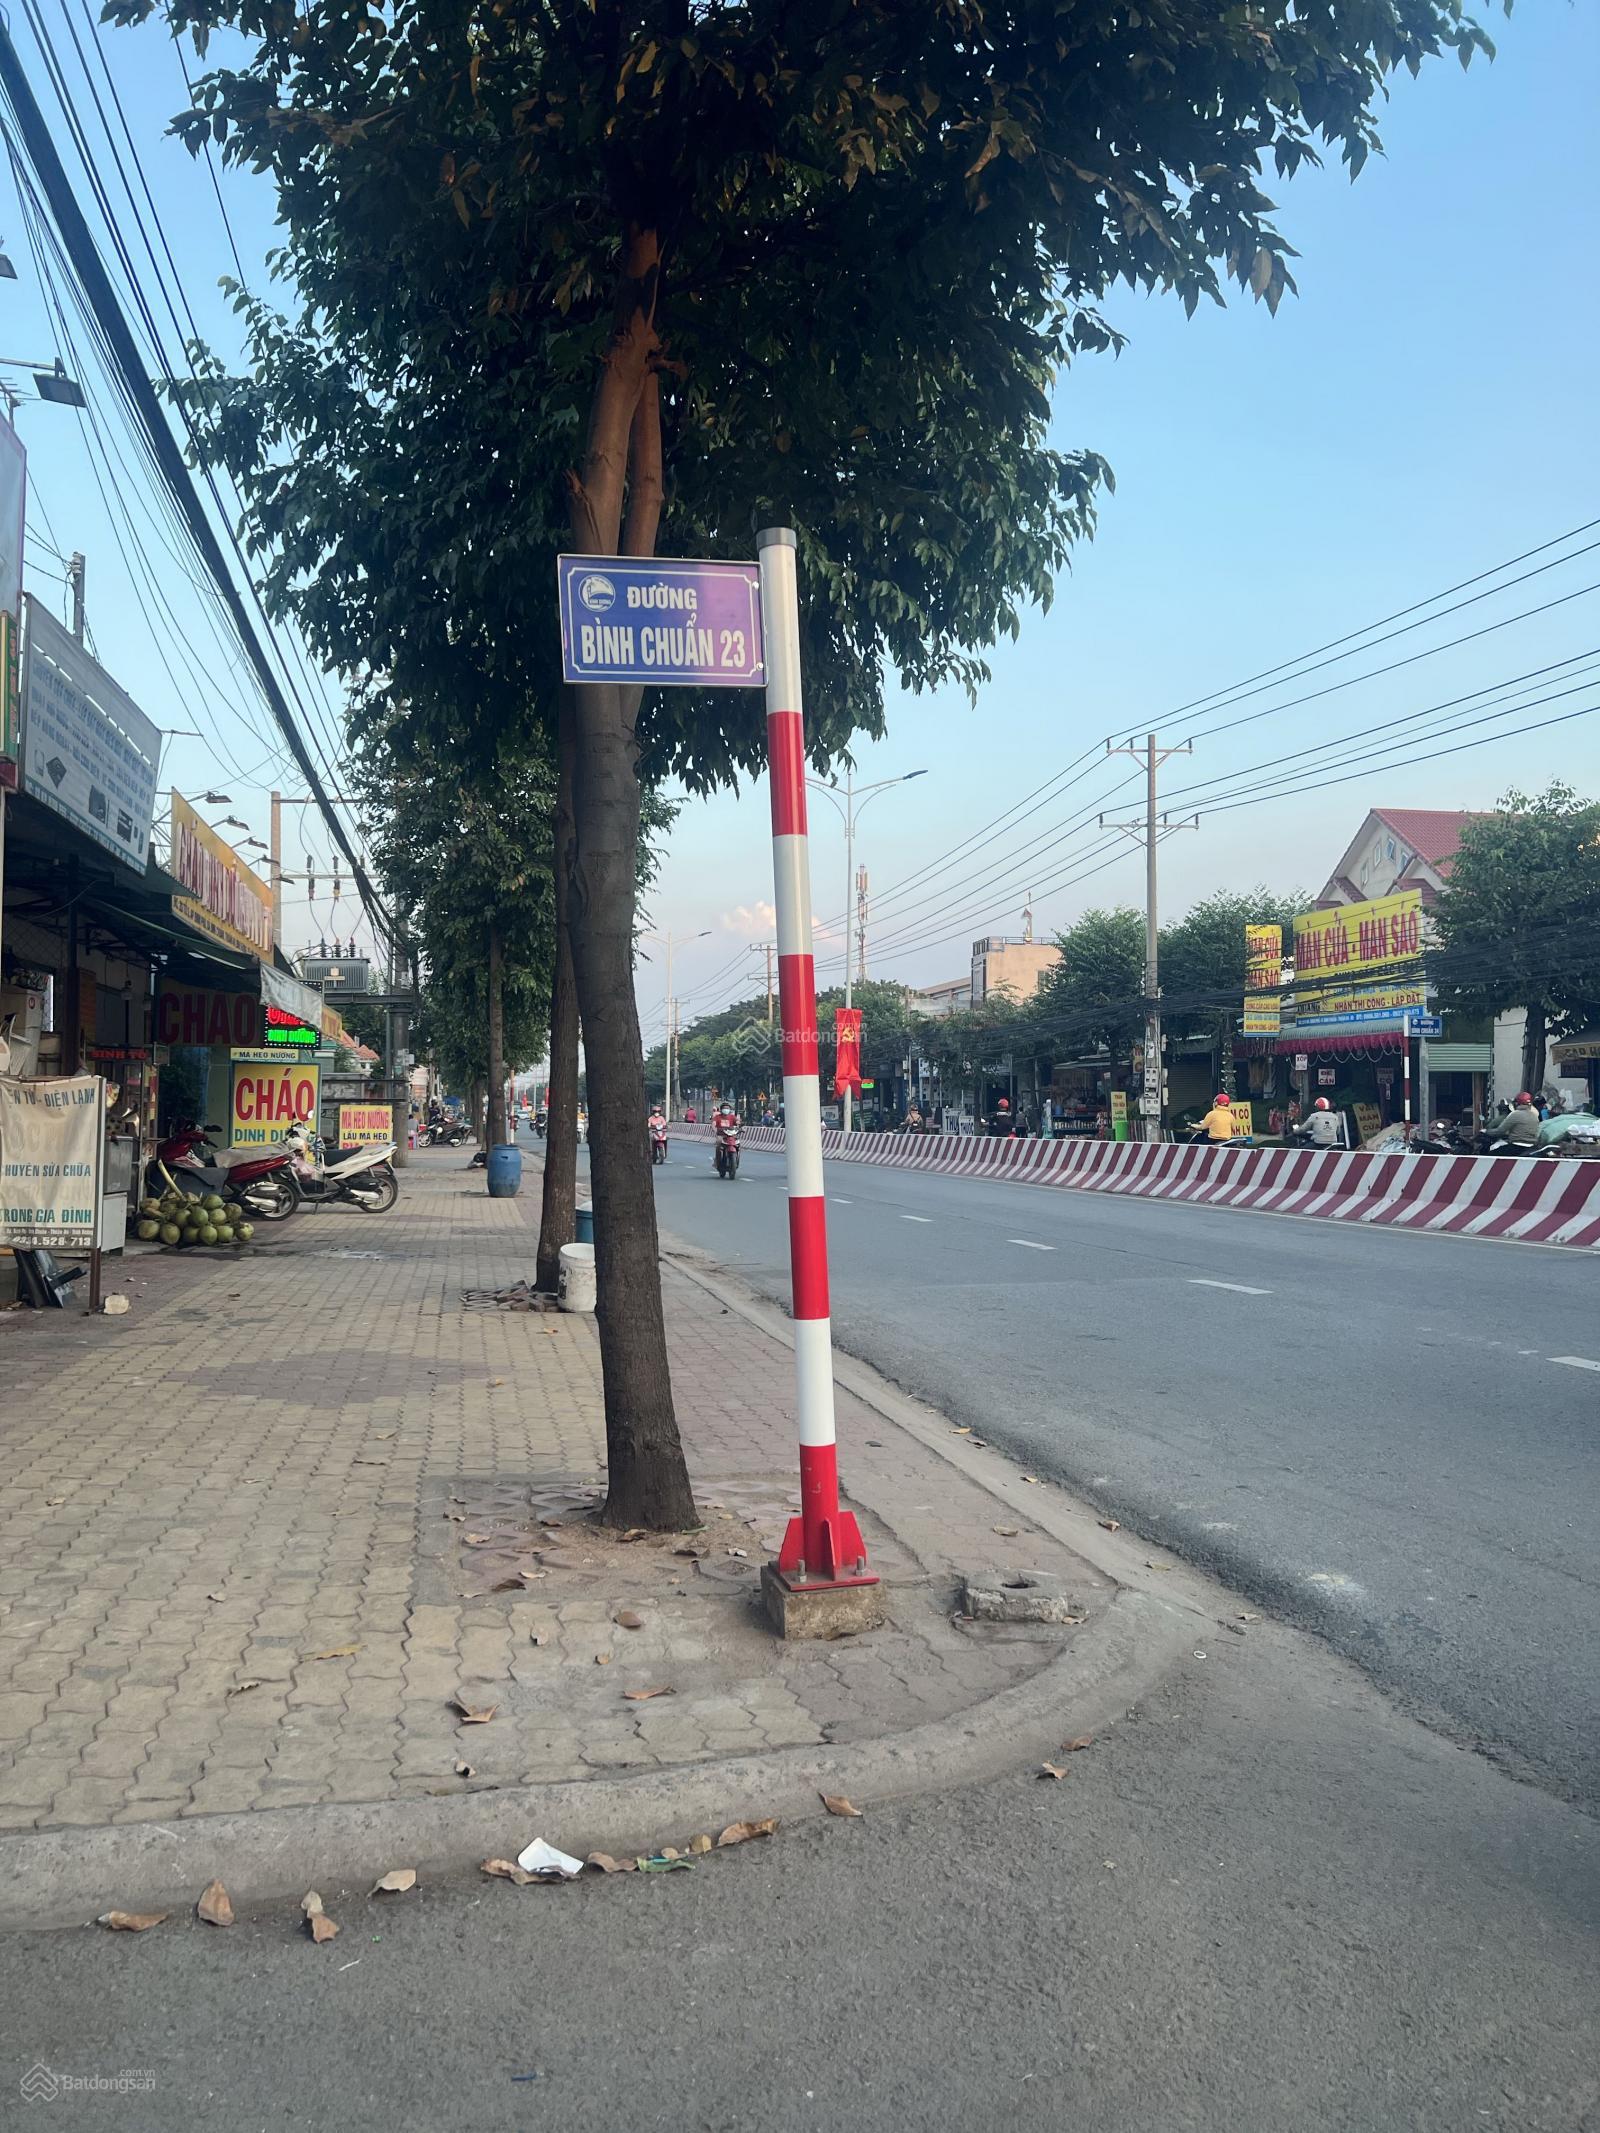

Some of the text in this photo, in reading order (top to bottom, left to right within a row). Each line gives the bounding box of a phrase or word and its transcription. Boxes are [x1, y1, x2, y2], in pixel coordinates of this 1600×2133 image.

[627, 582, 698, 610] ĐƯỜNG
[581, 613, 746, 668] BÌNH CHUẨN 23
[1296, 921, 1321, 971] MÀN
[1325, 911, 1348, 967] CỬA
[1360, 907, 1387, 961] MÀN
[1391, 901, 1417, 957] SÁO
[44, 1089, 70, 1110] ĐIỆN
[72, 1087, 96, 1108] LẠNH
[235, 1067, 315, 1122] CHÁO
[235, 1128, 265, 1143] DINH
[373, 1132, 388, 1140] HEO
[3, 1161, 40, 1177] HUYÊN
[35, 1208, 55, 1223] GIA
[61, 1205, 92, 1223] ĐÌNH
